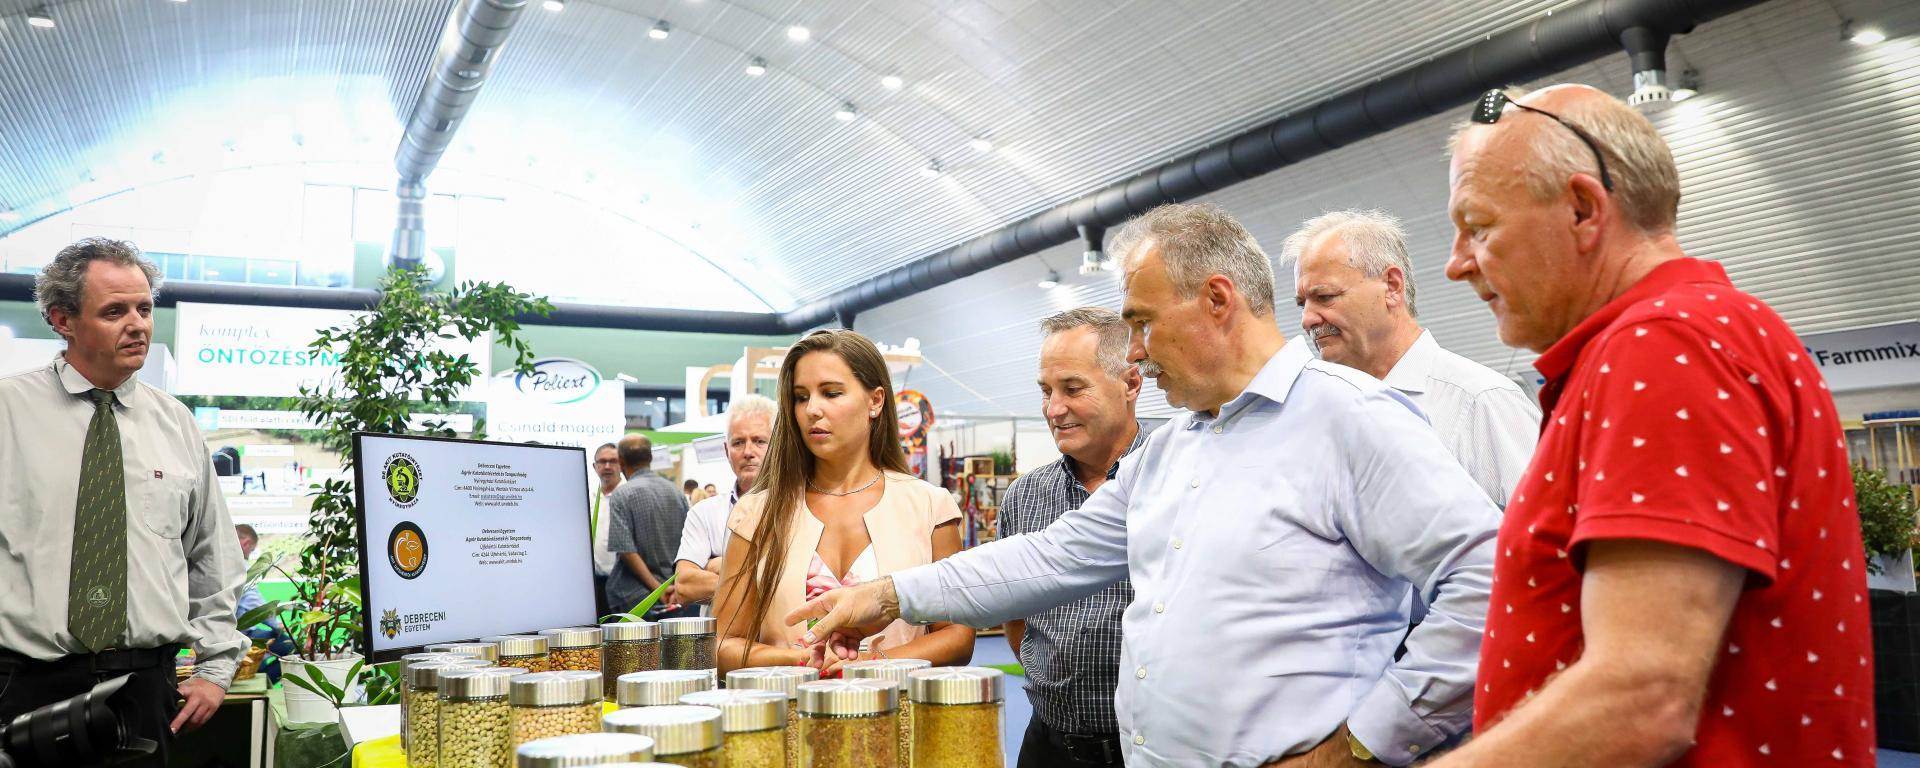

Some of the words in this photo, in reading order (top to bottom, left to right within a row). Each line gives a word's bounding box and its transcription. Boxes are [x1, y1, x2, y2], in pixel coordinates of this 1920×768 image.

[1815, 342, 1920, 367] Farmmix
[532, 371, 588, 391] Poliext
[403, 611, 446, 624] DEBRECENI
[404, 623, 431, 633] EGYETEM
